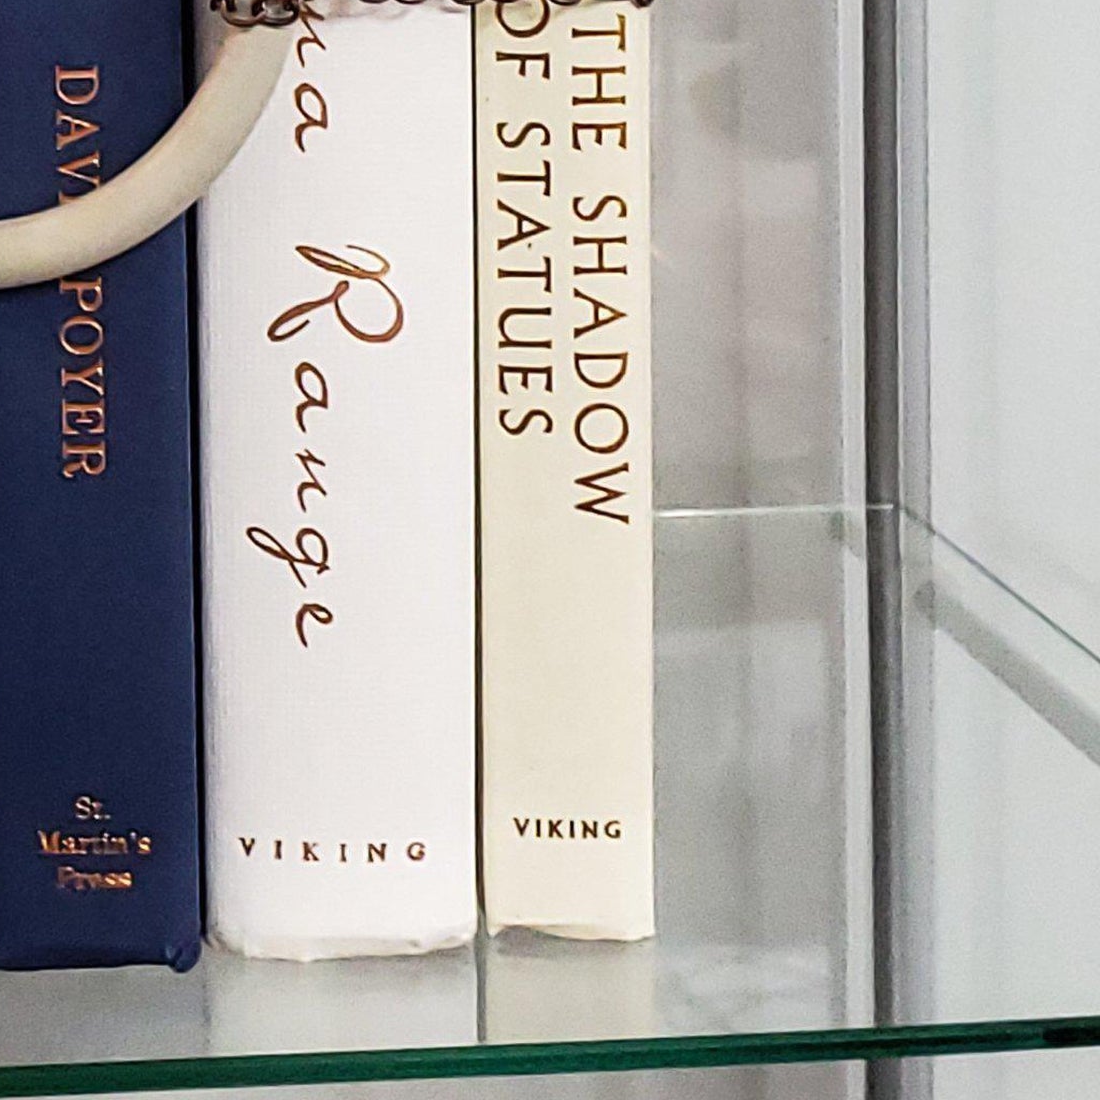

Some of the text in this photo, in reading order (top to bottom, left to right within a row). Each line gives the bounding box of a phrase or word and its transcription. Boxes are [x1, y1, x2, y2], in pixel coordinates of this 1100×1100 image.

[571, 13, 627, 151] THE
[55, 65, 107, 479] DAV POYER
[496, 121, 554, 437] STATUES
[572, 194, 630, 525] SHADOW
[246, 244, 404, 648] Range
[37, 830, 151, 855] Martin's
[75, 796, 111, 819] St.
[513, 816, 621, 840] VIKING
[56, 866, 132, 890] Press
[238, 837, 427, 863] VIKING
